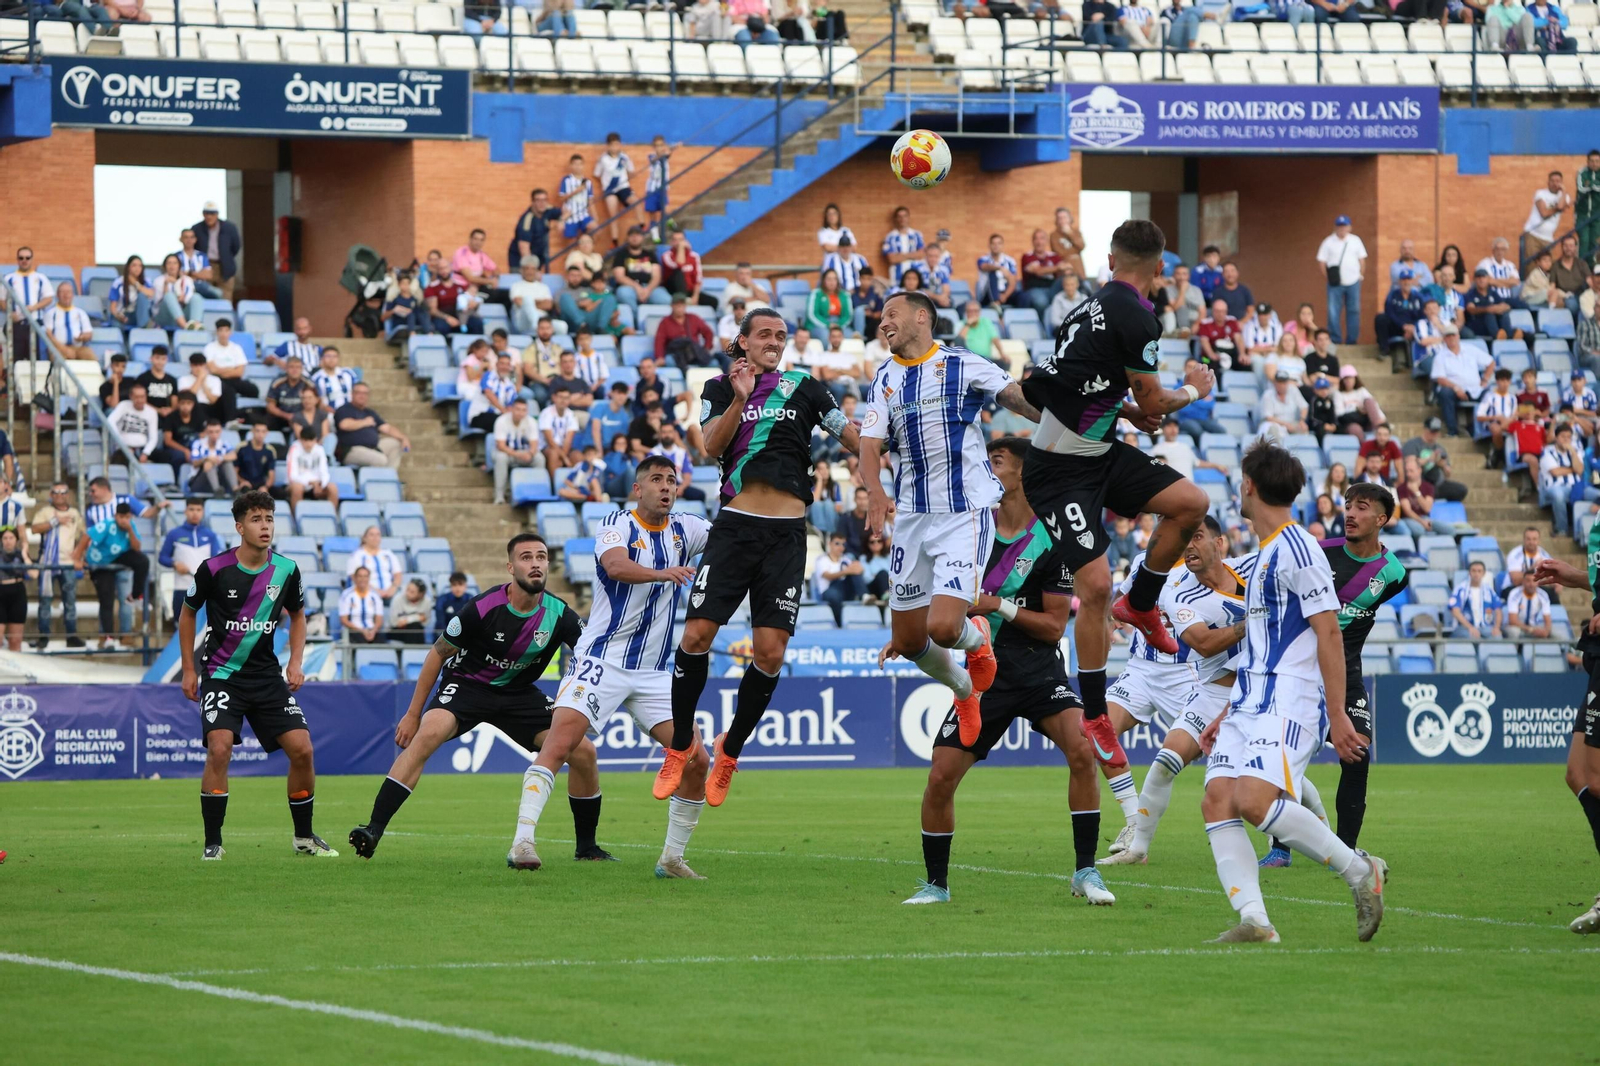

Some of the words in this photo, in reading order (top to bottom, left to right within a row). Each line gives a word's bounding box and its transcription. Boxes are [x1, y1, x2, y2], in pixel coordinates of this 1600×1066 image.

[102, 73, 241, 101] ONUFER
[175, 100, 241, 111] INDUSTRIAL
[326, 105, 338, 114] DE
[385, 107, 391, 115] Y
[1157, 100, 1199, 120] LOS
[1204, 100, 1305, 121] ROMEROS
[1311, 100, 1341, 120] DE
[1350, 96, 1421, 120] ALANÍS
[1157, 125, 1221, 140] JAMONES,
[1223, 125, 1275, 139] PALETAS
[1277, 125, 1286, 138] Y
[1289, 125, 1361, 139] EMBUTIDOS
[1064, 502, 1087, 532] 9
[890, 544, 905, 575] 18
[695, 565, 711, 590] 4
[895, 583, 921, 596] Olin
[787, 645, 838, 665] PEÑA
[578, 659, 604, 686] 23
[442, 683, 459, 695] 5
[1107, 685, 1130, 697] Olin
[204, 690, 230, 711] 22
[1185, 711, 1207, 731] Olin
[55, 729, 84, 740] REAL
[86, 728, 117, 740] CLUB
[146, 723, 171, 735] 1889
[1502, 721, 1573, 735] PROVINCIA
[55, 741, 126, 752] RECREATIVO
[146, 738, 188, 749] Decano
[1516, 735, 1567, 748] HUELVA
[55, 754, 71, 765] DE
[72, 753, 117, 765] HUELVA
[146, 751, 169, 762] Bien
[171, 751, 186, 762] de
[187, 751, 208, 762] Inte
